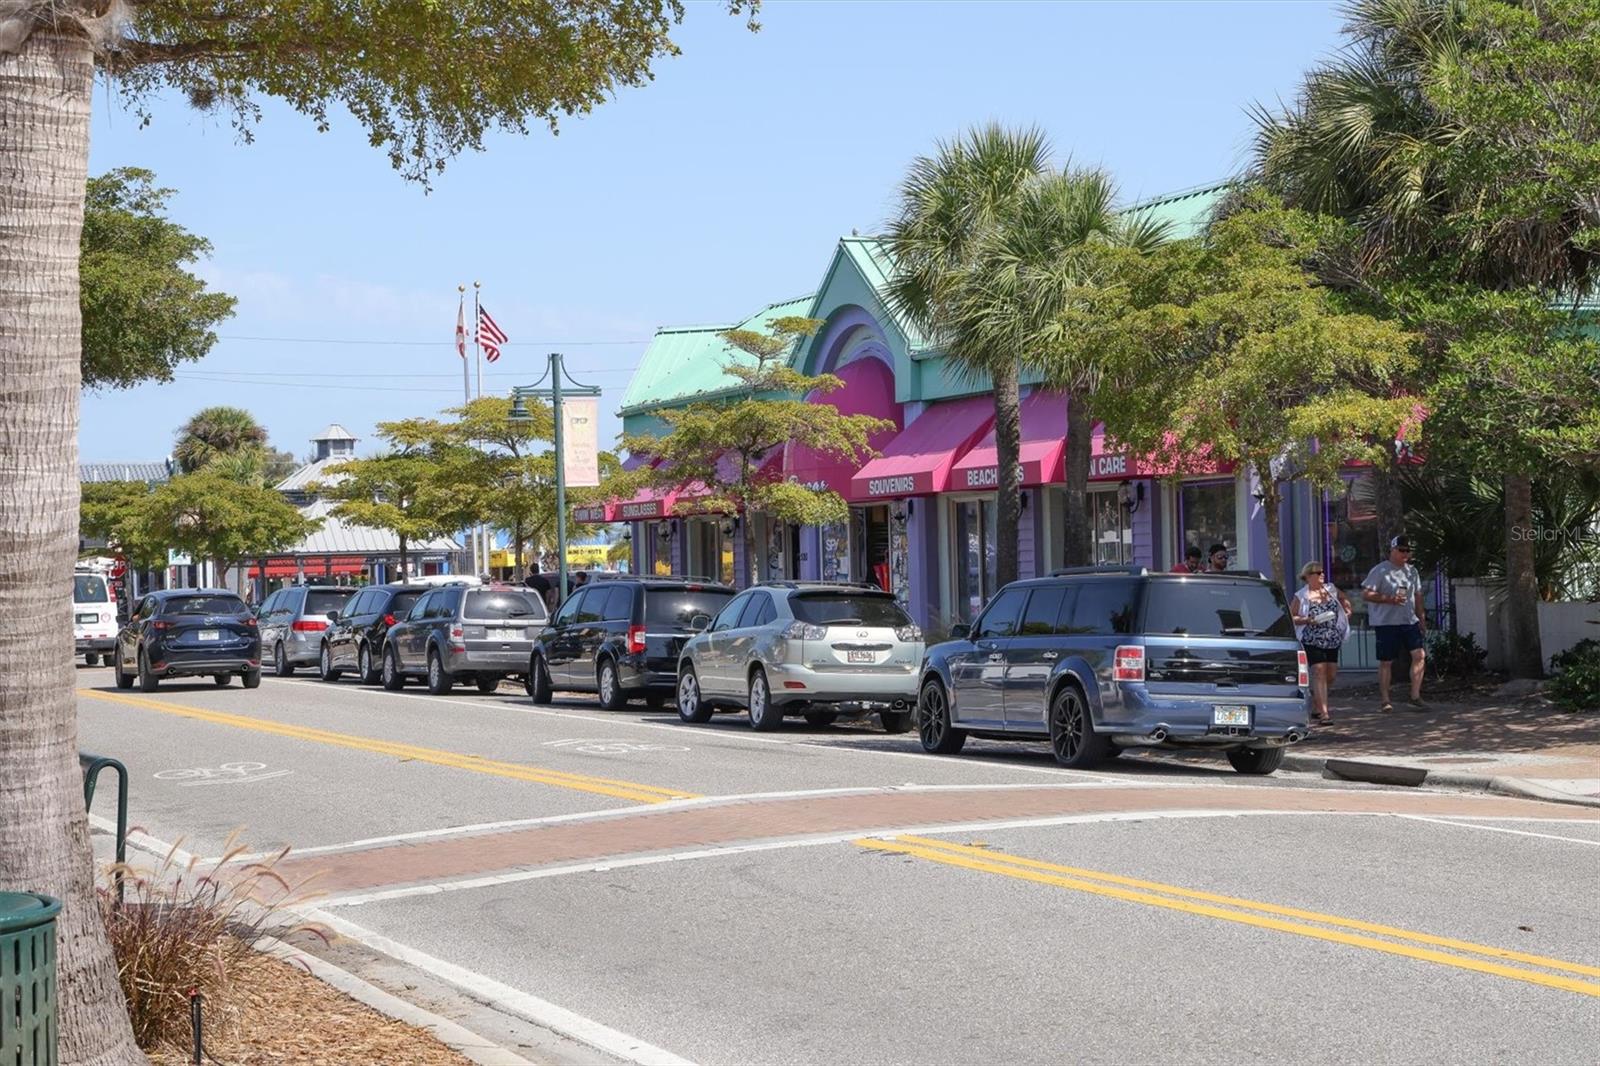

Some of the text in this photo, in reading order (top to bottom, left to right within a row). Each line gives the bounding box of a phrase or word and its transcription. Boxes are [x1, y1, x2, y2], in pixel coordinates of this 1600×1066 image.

[1099, 456, 1126, 476] CARE
[869, 476, 914, 495] SOUVENIRS
[967, 468, 998, 486] BEACH
[623, 503, 657, 518] SUNGLASSES
